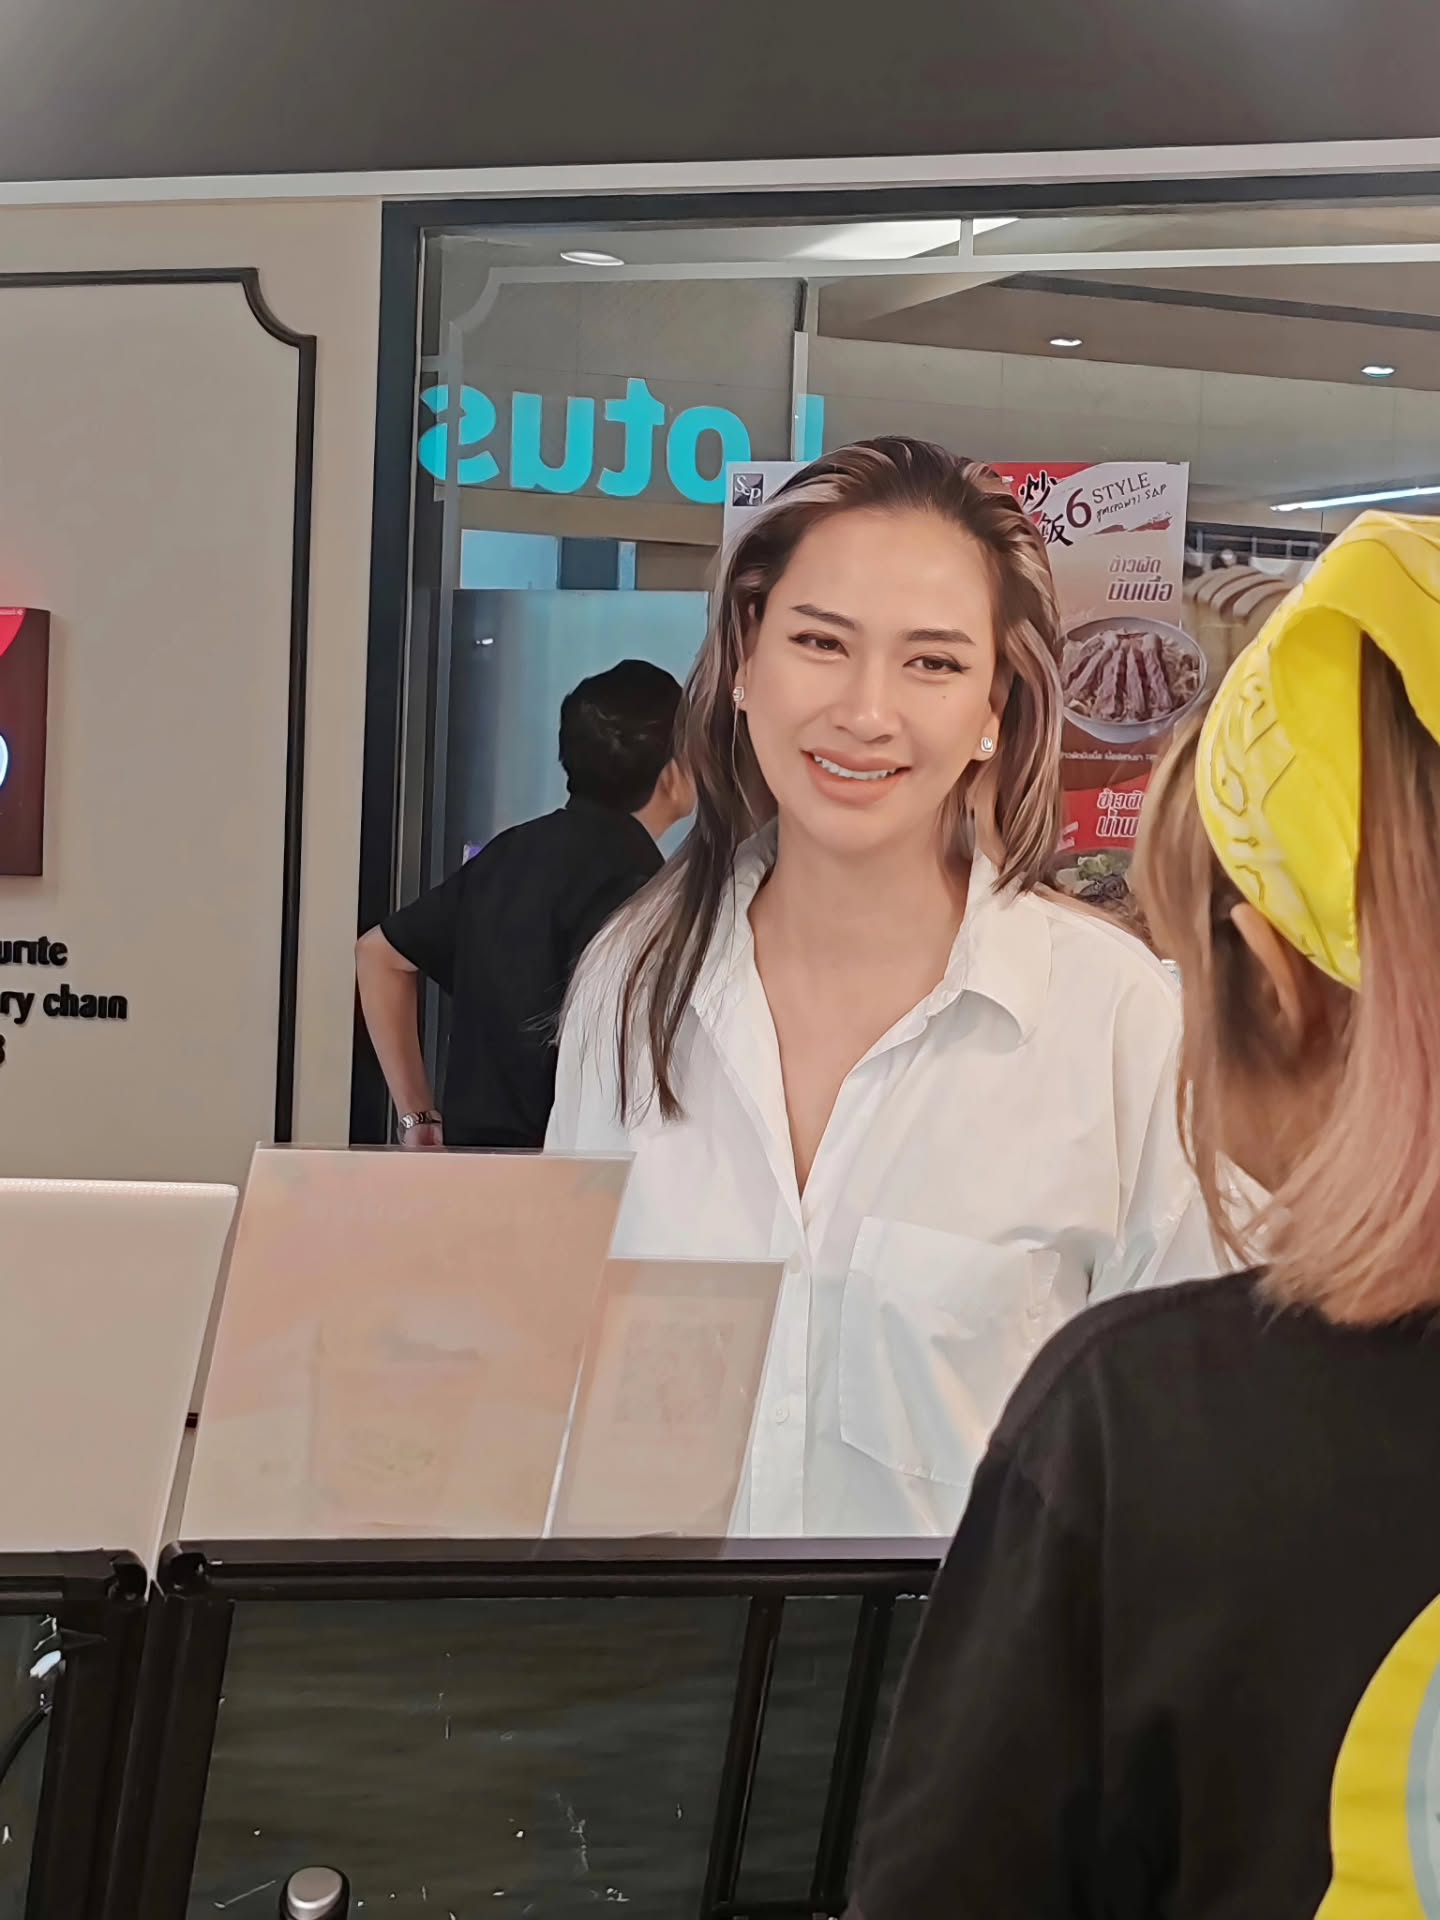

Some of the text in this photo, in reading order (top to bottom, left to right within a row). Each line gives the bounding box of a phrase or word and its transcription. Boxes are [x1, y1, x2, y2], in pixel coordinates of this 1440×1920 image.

[1066, 472, 1151, 529] 6 STYLE
[43, 984, 128, 1019] chain
